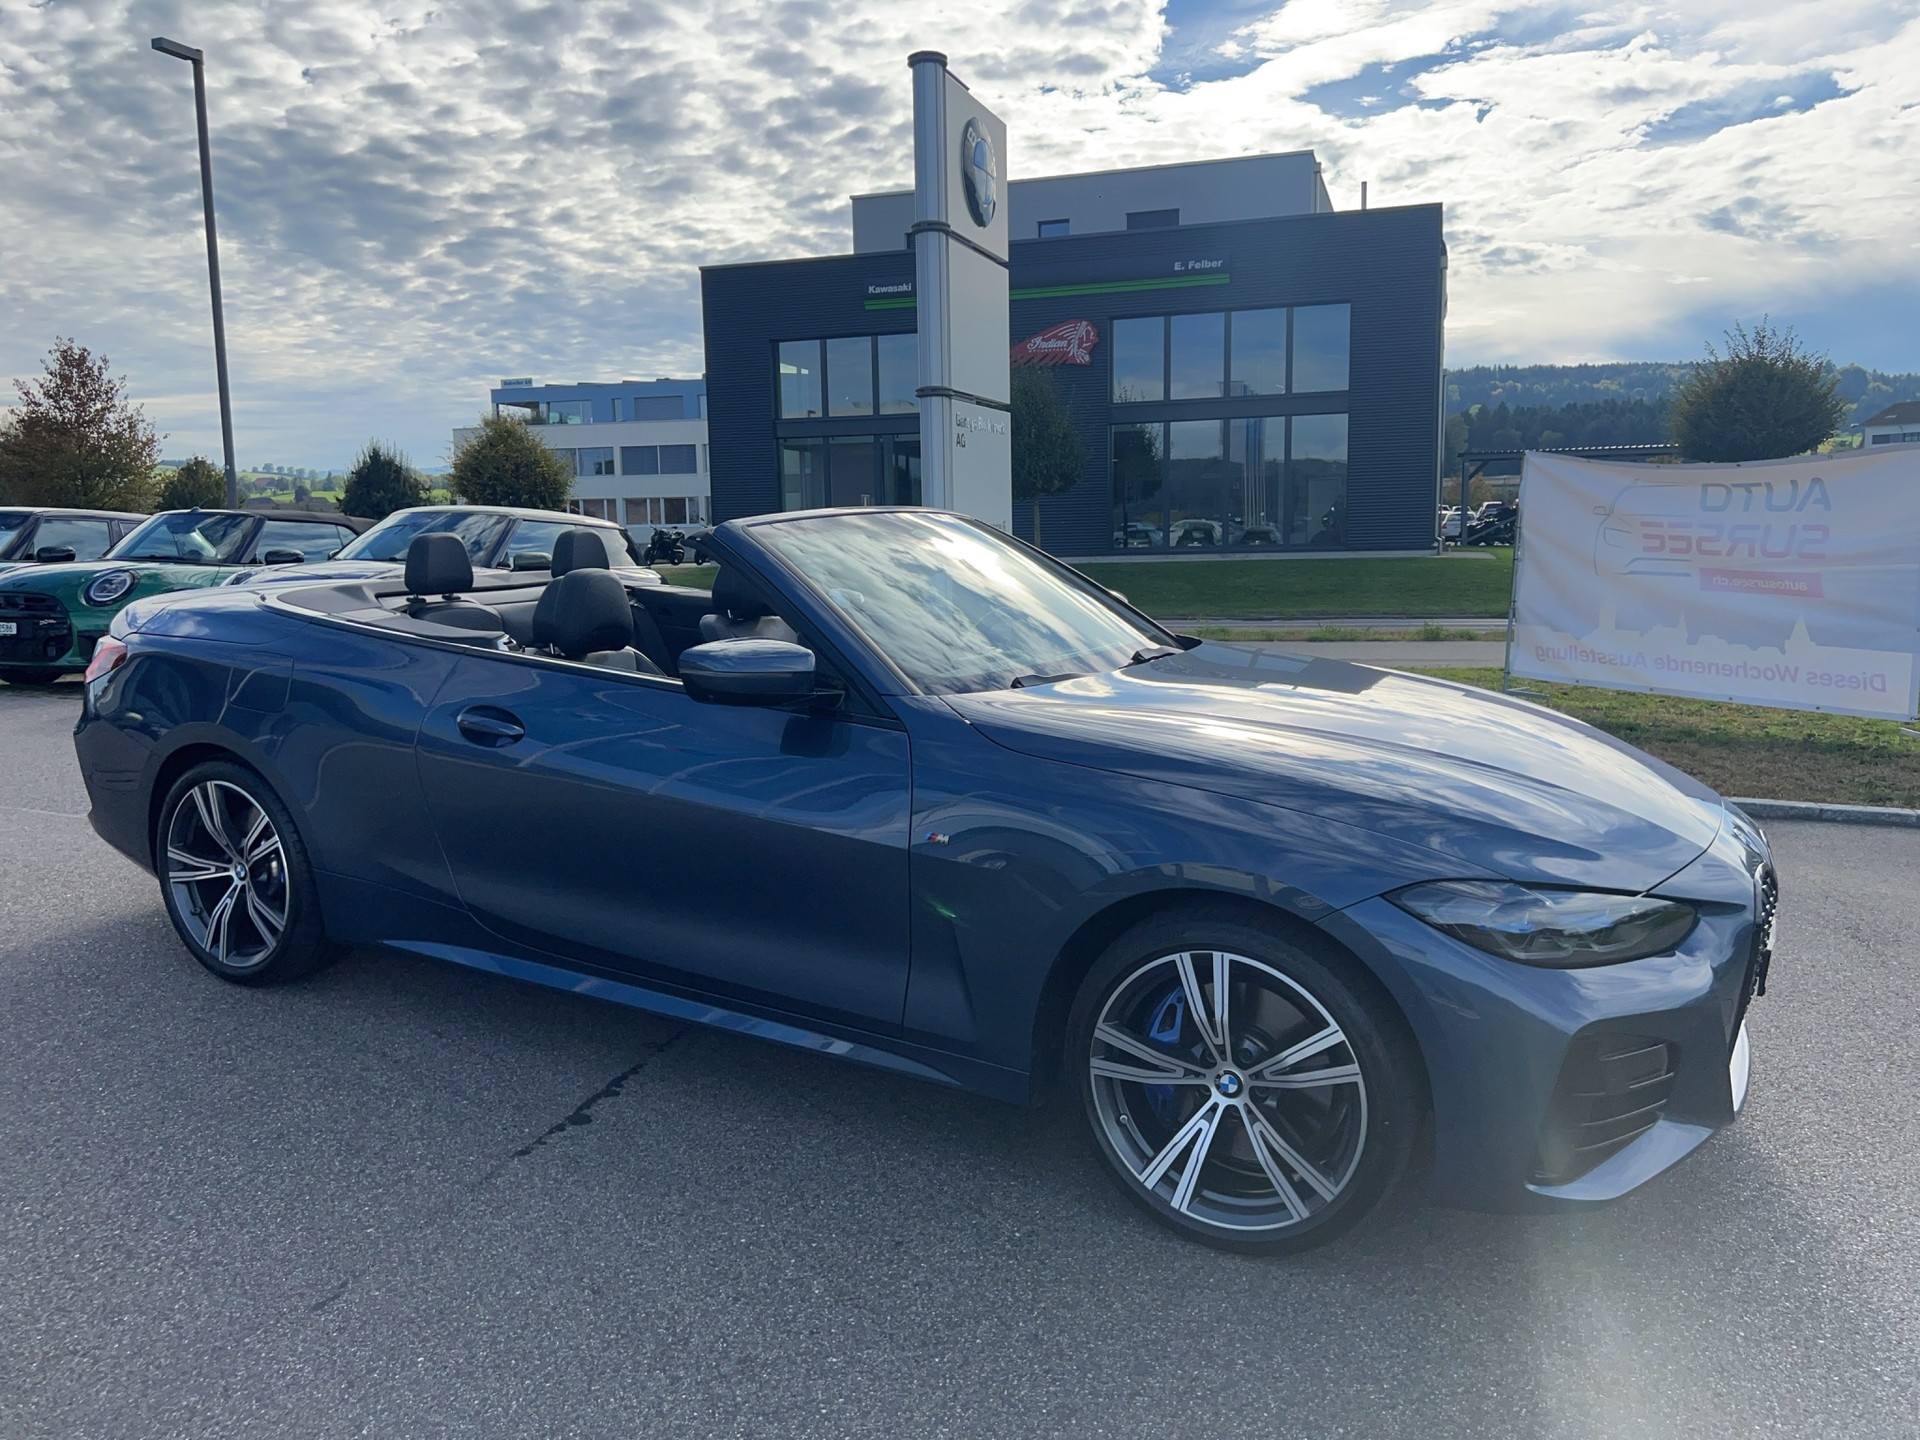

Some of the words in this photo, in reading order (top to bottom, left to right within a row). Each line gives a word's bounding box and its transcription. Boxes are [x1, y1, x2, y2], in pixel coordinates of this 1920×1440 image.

[1174, 261, 1185, 271] E.
[1188, 259, 1224, 270] Felber
[868, 282, 912, 294] Kawasaki
[1026, 336, 1068, 350] Indian
[955, 432, 966, 448] AG
